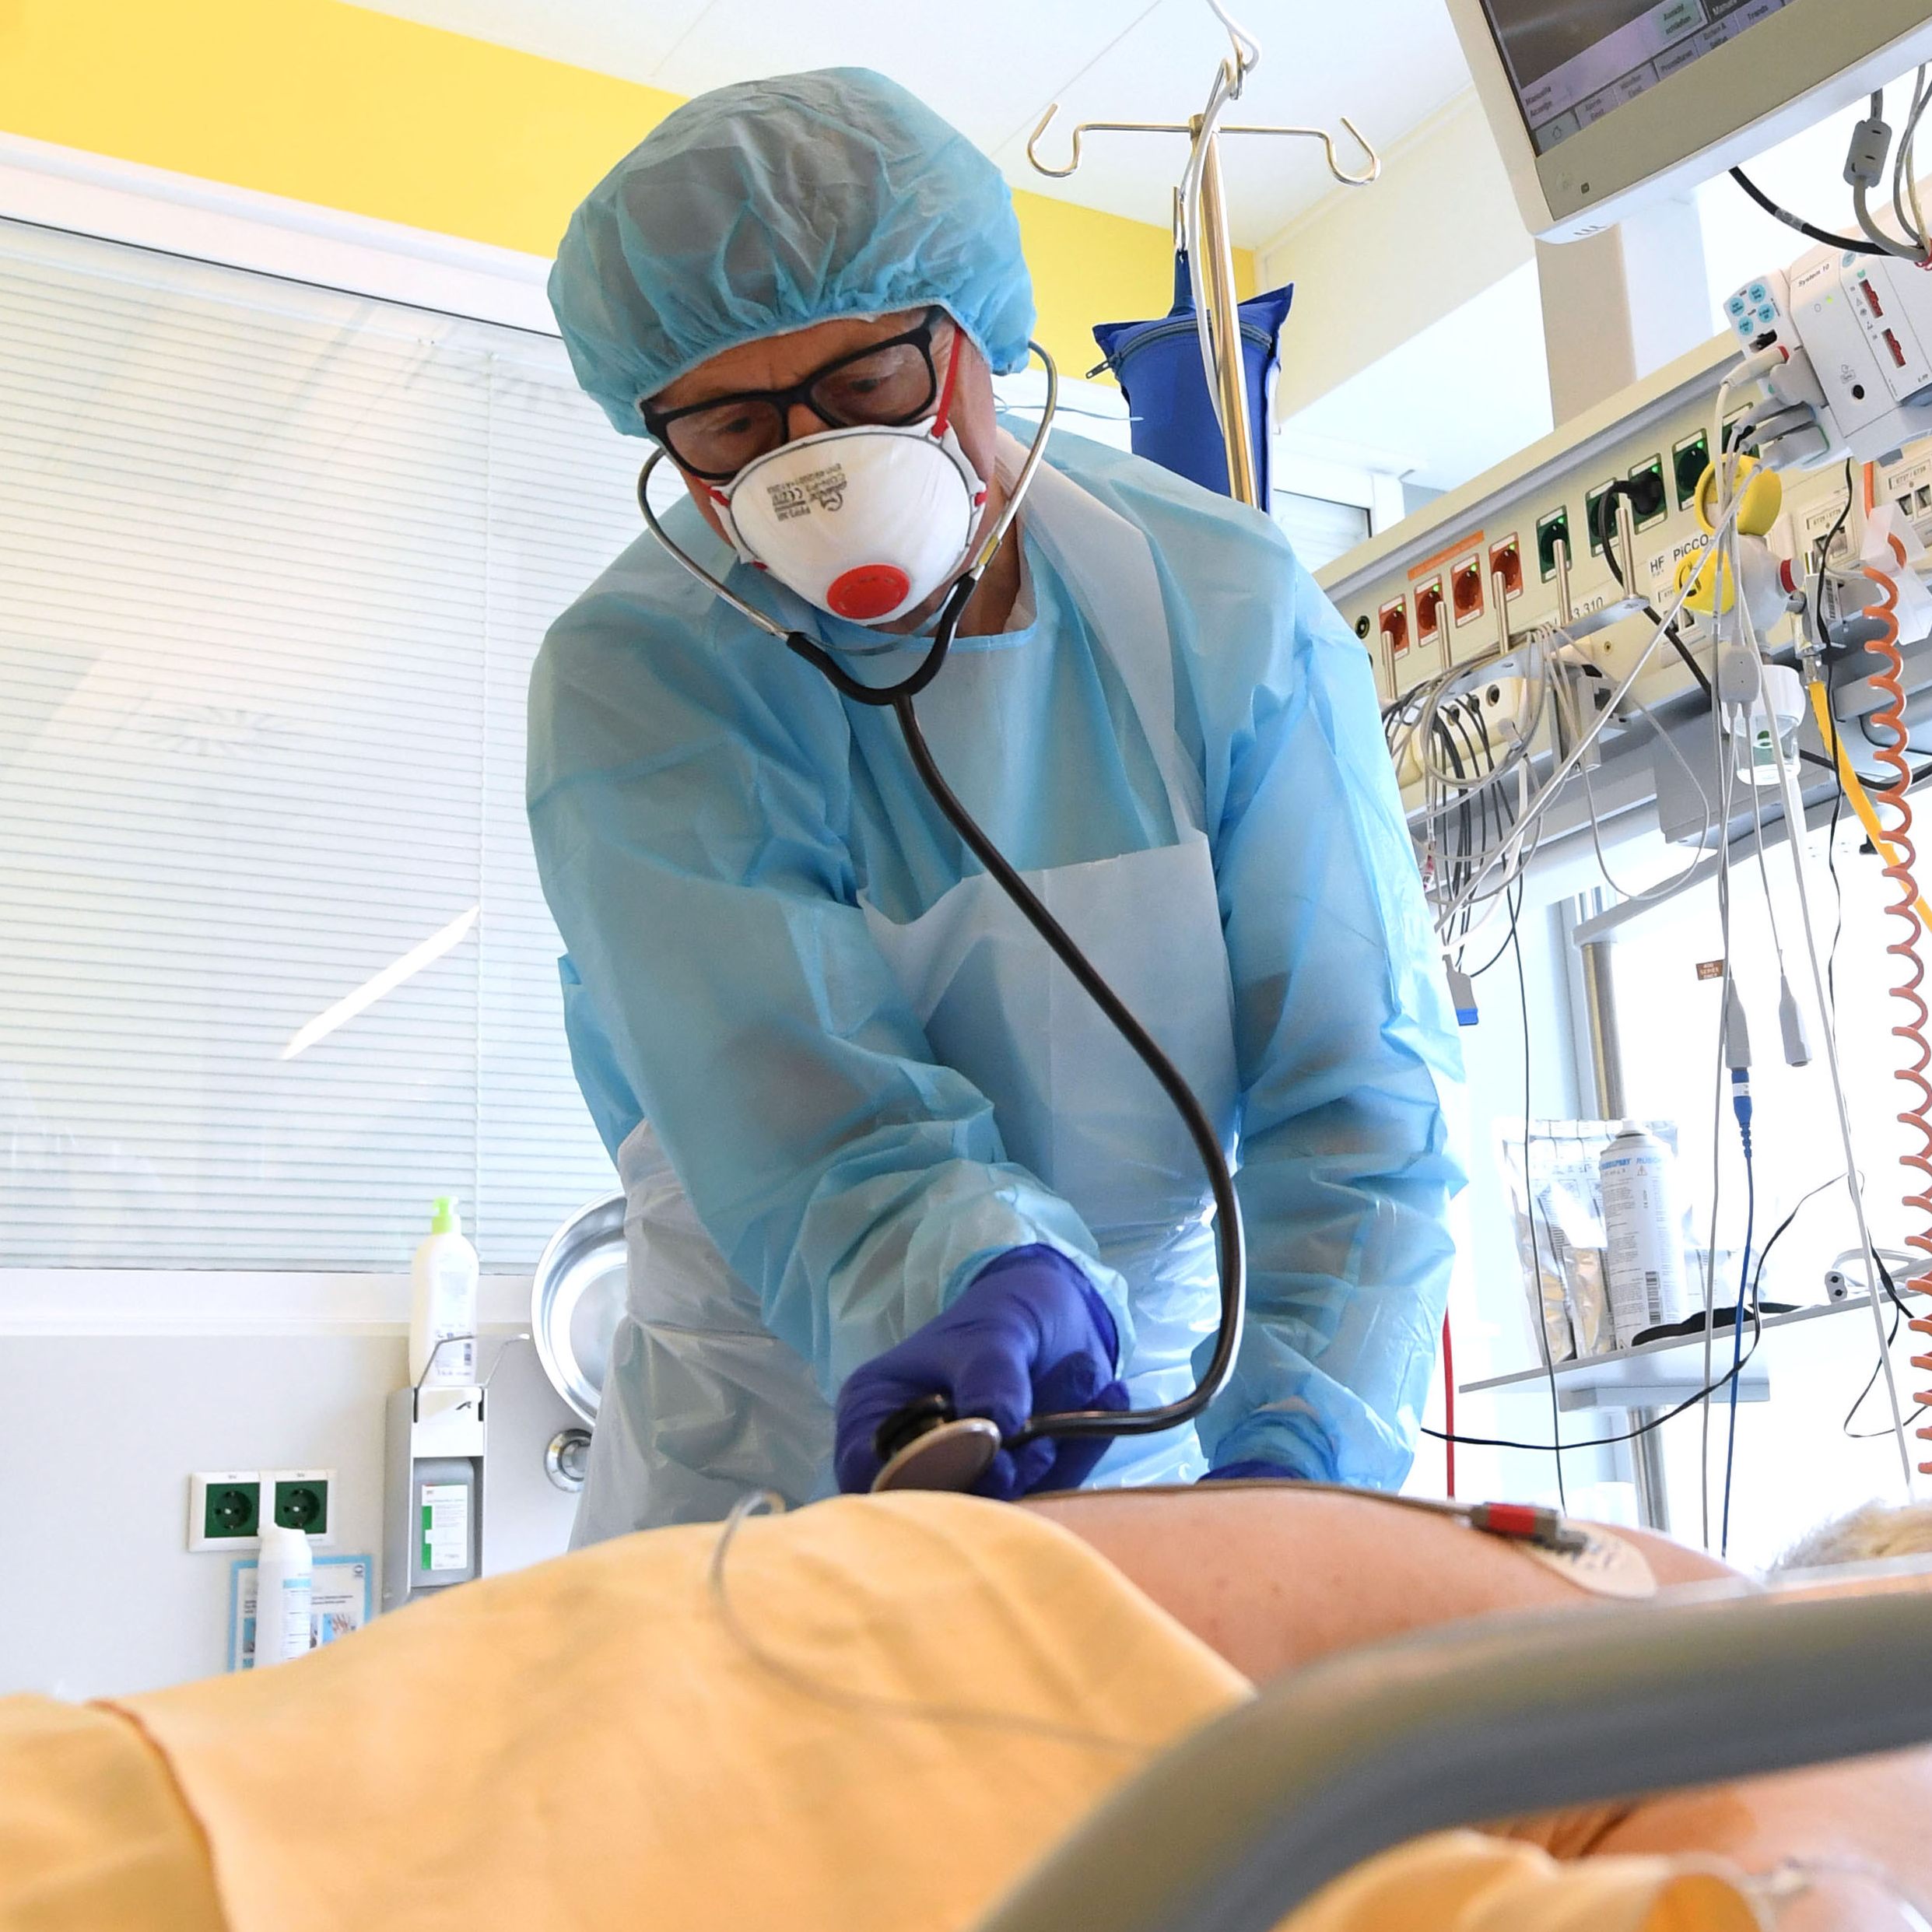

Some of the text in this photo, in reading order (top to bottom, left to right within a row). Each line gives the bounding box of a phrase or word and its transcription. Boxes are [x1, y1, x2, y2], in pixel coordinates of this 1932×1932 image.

[1797, 263, 1830, 287] System 10
[1650, 556, 1665, 573] HF
